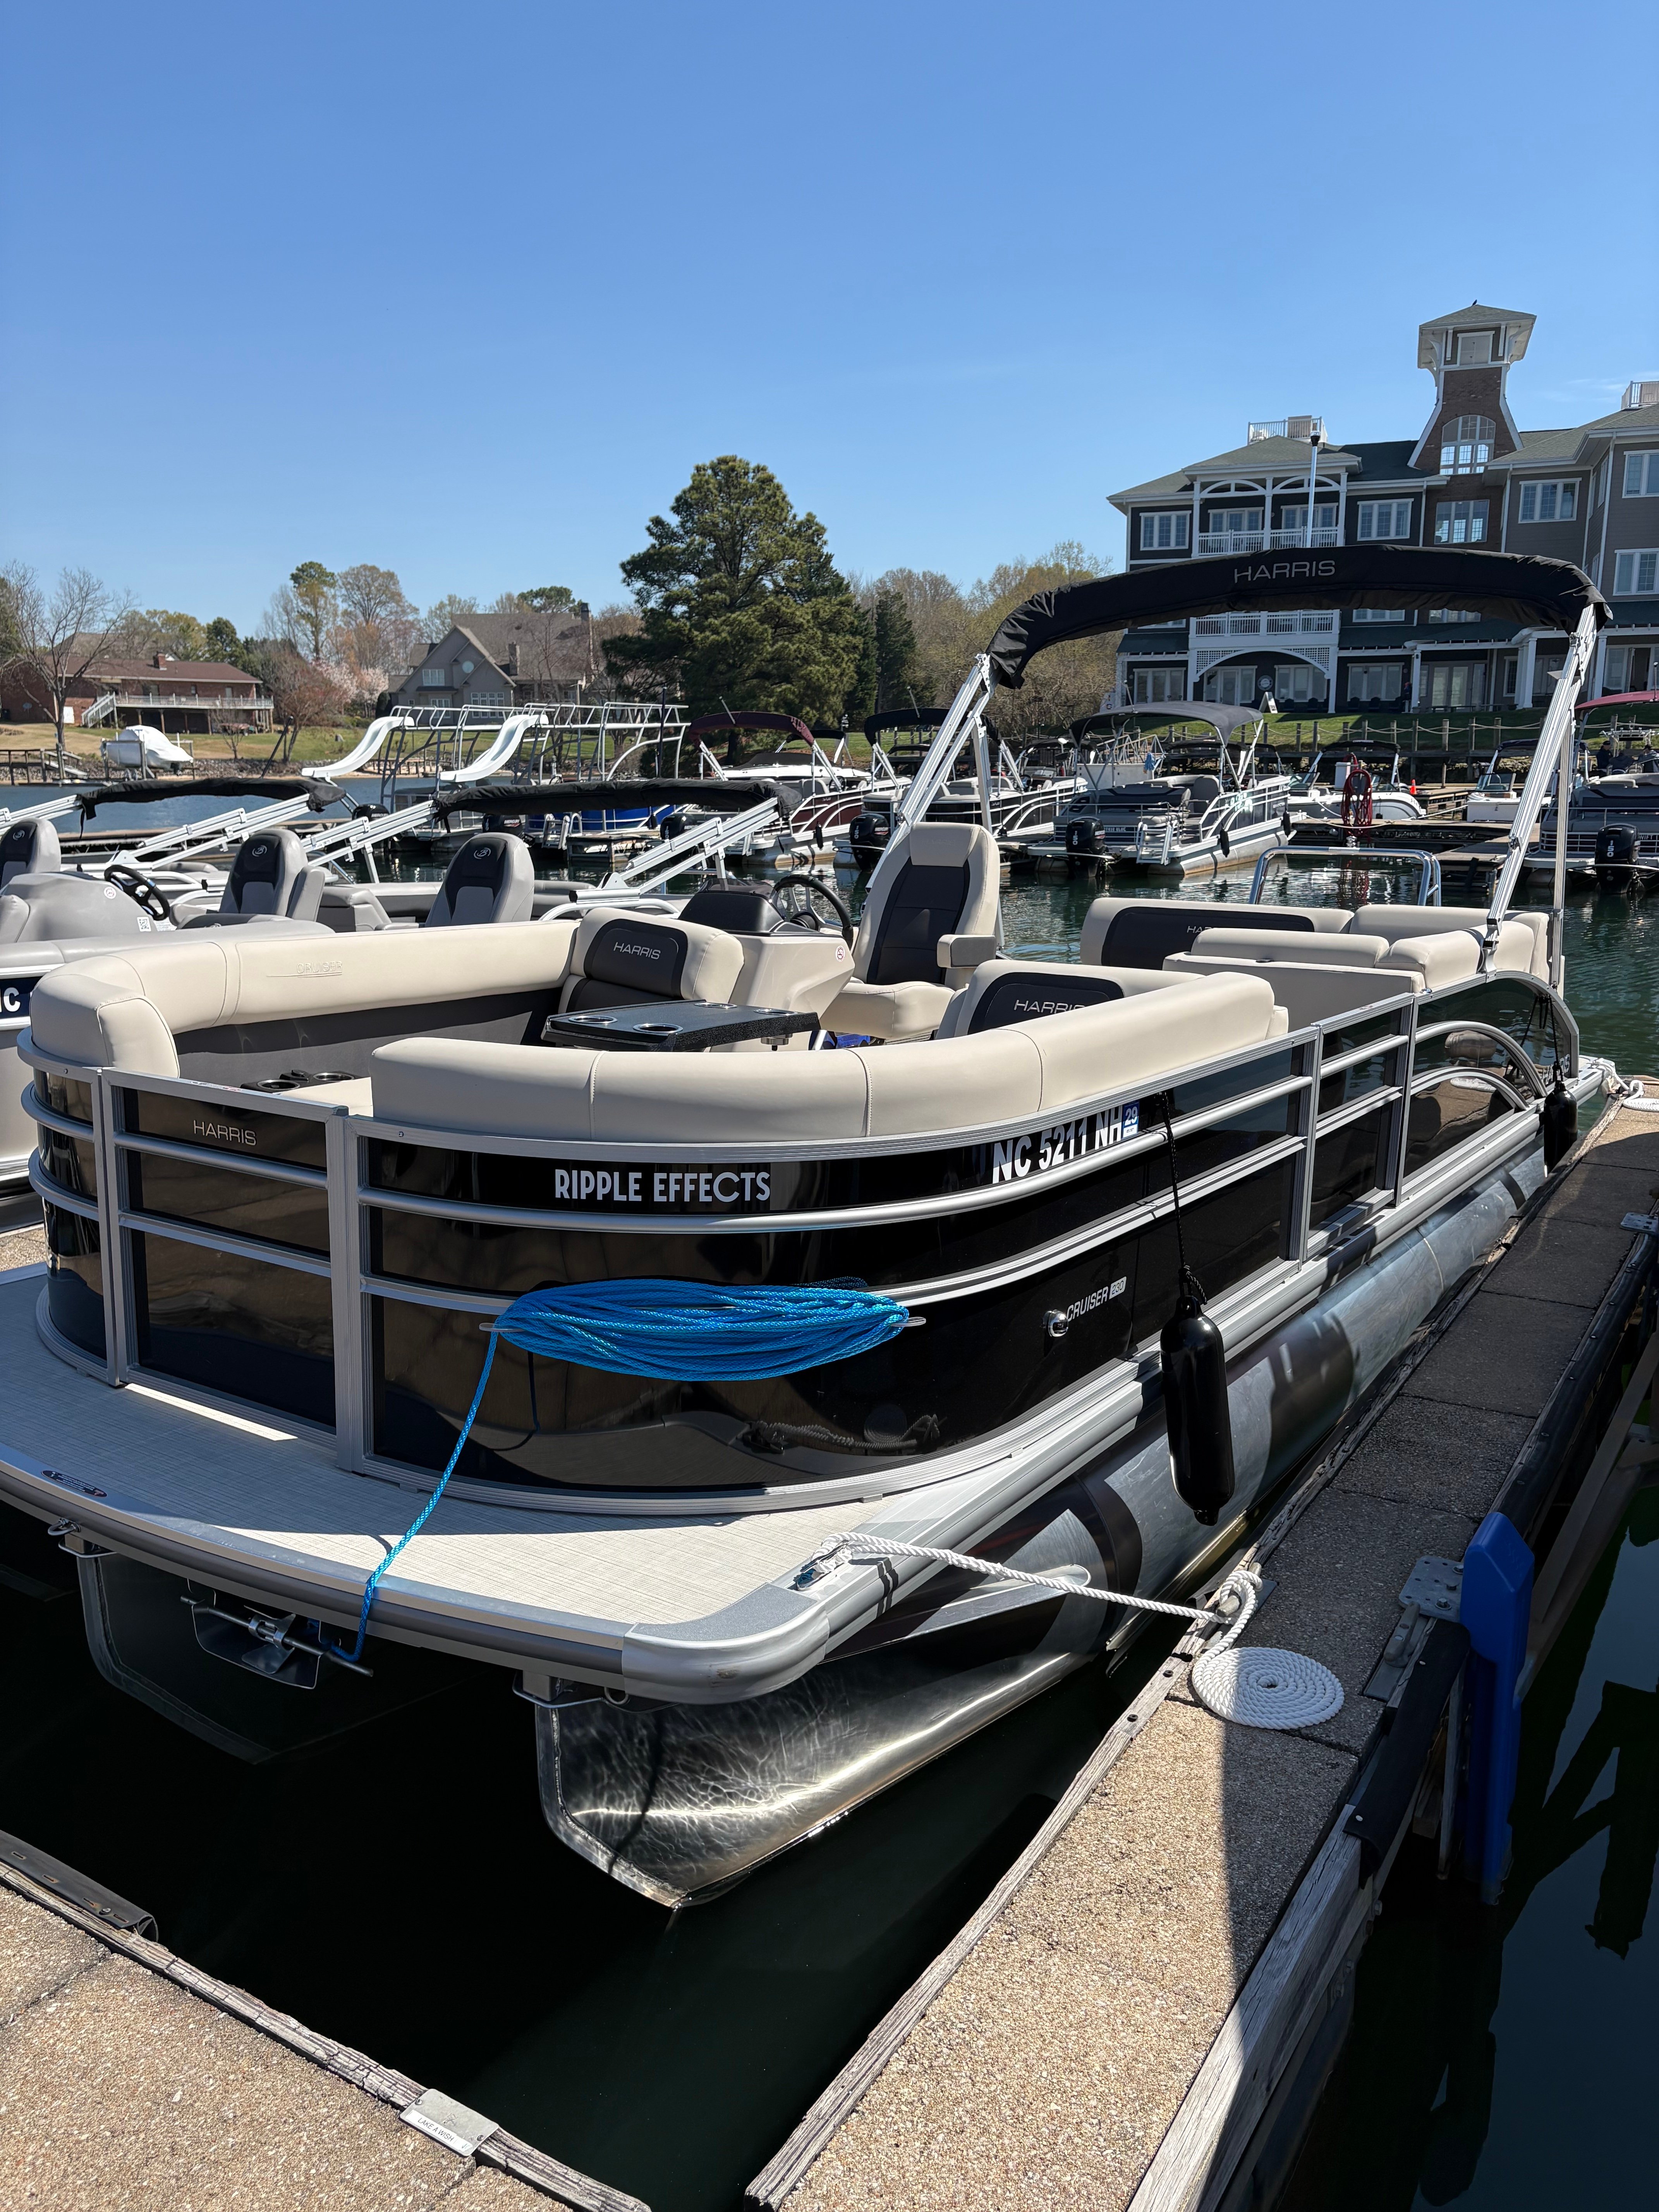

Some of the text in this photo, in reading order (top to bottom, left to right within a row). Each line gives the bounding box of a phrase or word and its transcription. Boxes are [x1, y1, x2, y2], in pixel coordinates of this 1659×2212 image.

[1234, 560, 1336, 584] HARRIS
[613, 942, 661, 960] HARRIS
[297, 960, 343, 974] CRUISER
[0, 988, 21, 1012] C
[1125, 1106, 1138, 1126] 29
[194, 1120, 256, 1146] HARRIS
[993, 1105, 1123, 1184] NC 5211 NH
[555, 1169, 770, 1202] RIPPLE EFFECTS
[1066, 1280, 1124, 1322] CRUISER 230
[417, 2118, 434, 2130] LAKE
[438, 2129, 455, 2142] WISH
